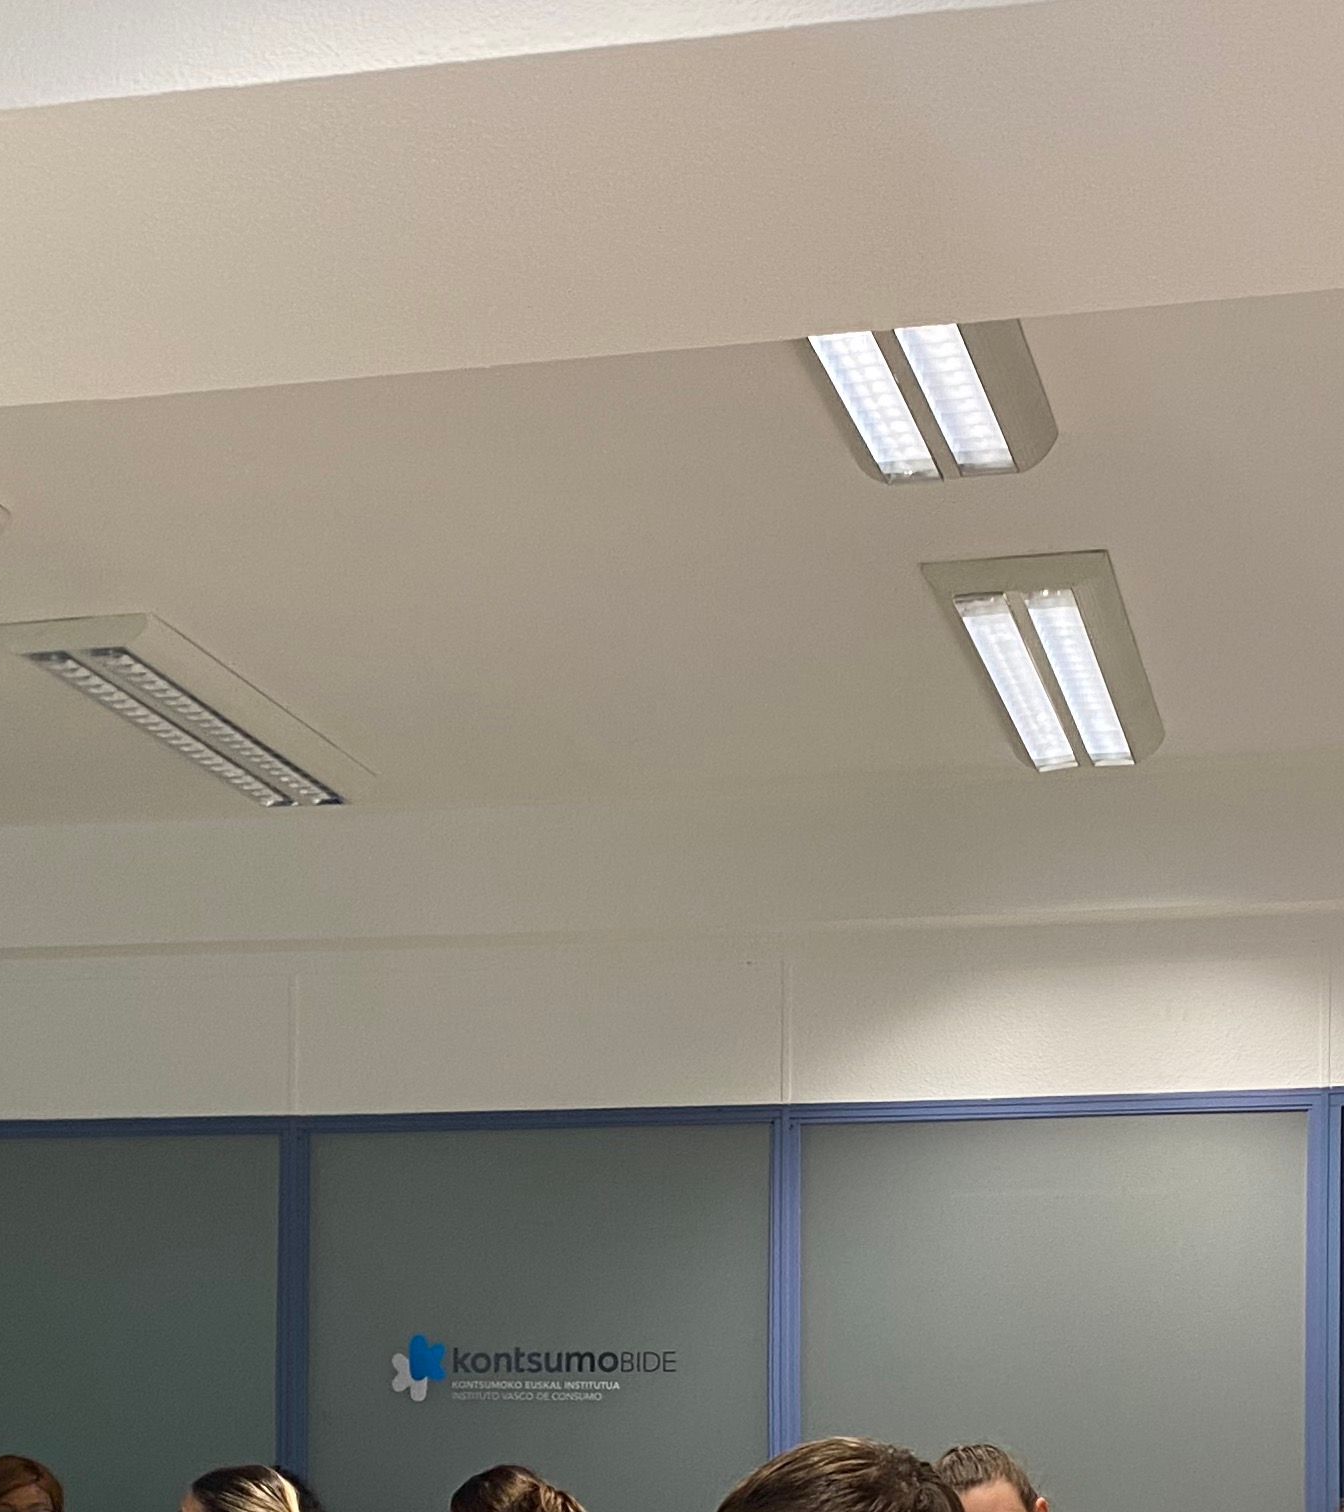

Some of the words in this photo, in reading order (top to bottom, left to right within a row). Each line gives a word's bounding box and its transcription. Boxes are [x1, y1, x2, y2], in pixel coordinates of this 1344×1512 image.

[452, 1346, 677, 1374] kontsumoBIDE
[451, 1380, 523, 1390] KONTSUMOKO
[524, 1380, 562, 1390] EUSKAL
[563, 1380, 620, 1390] INSTITUTUA
